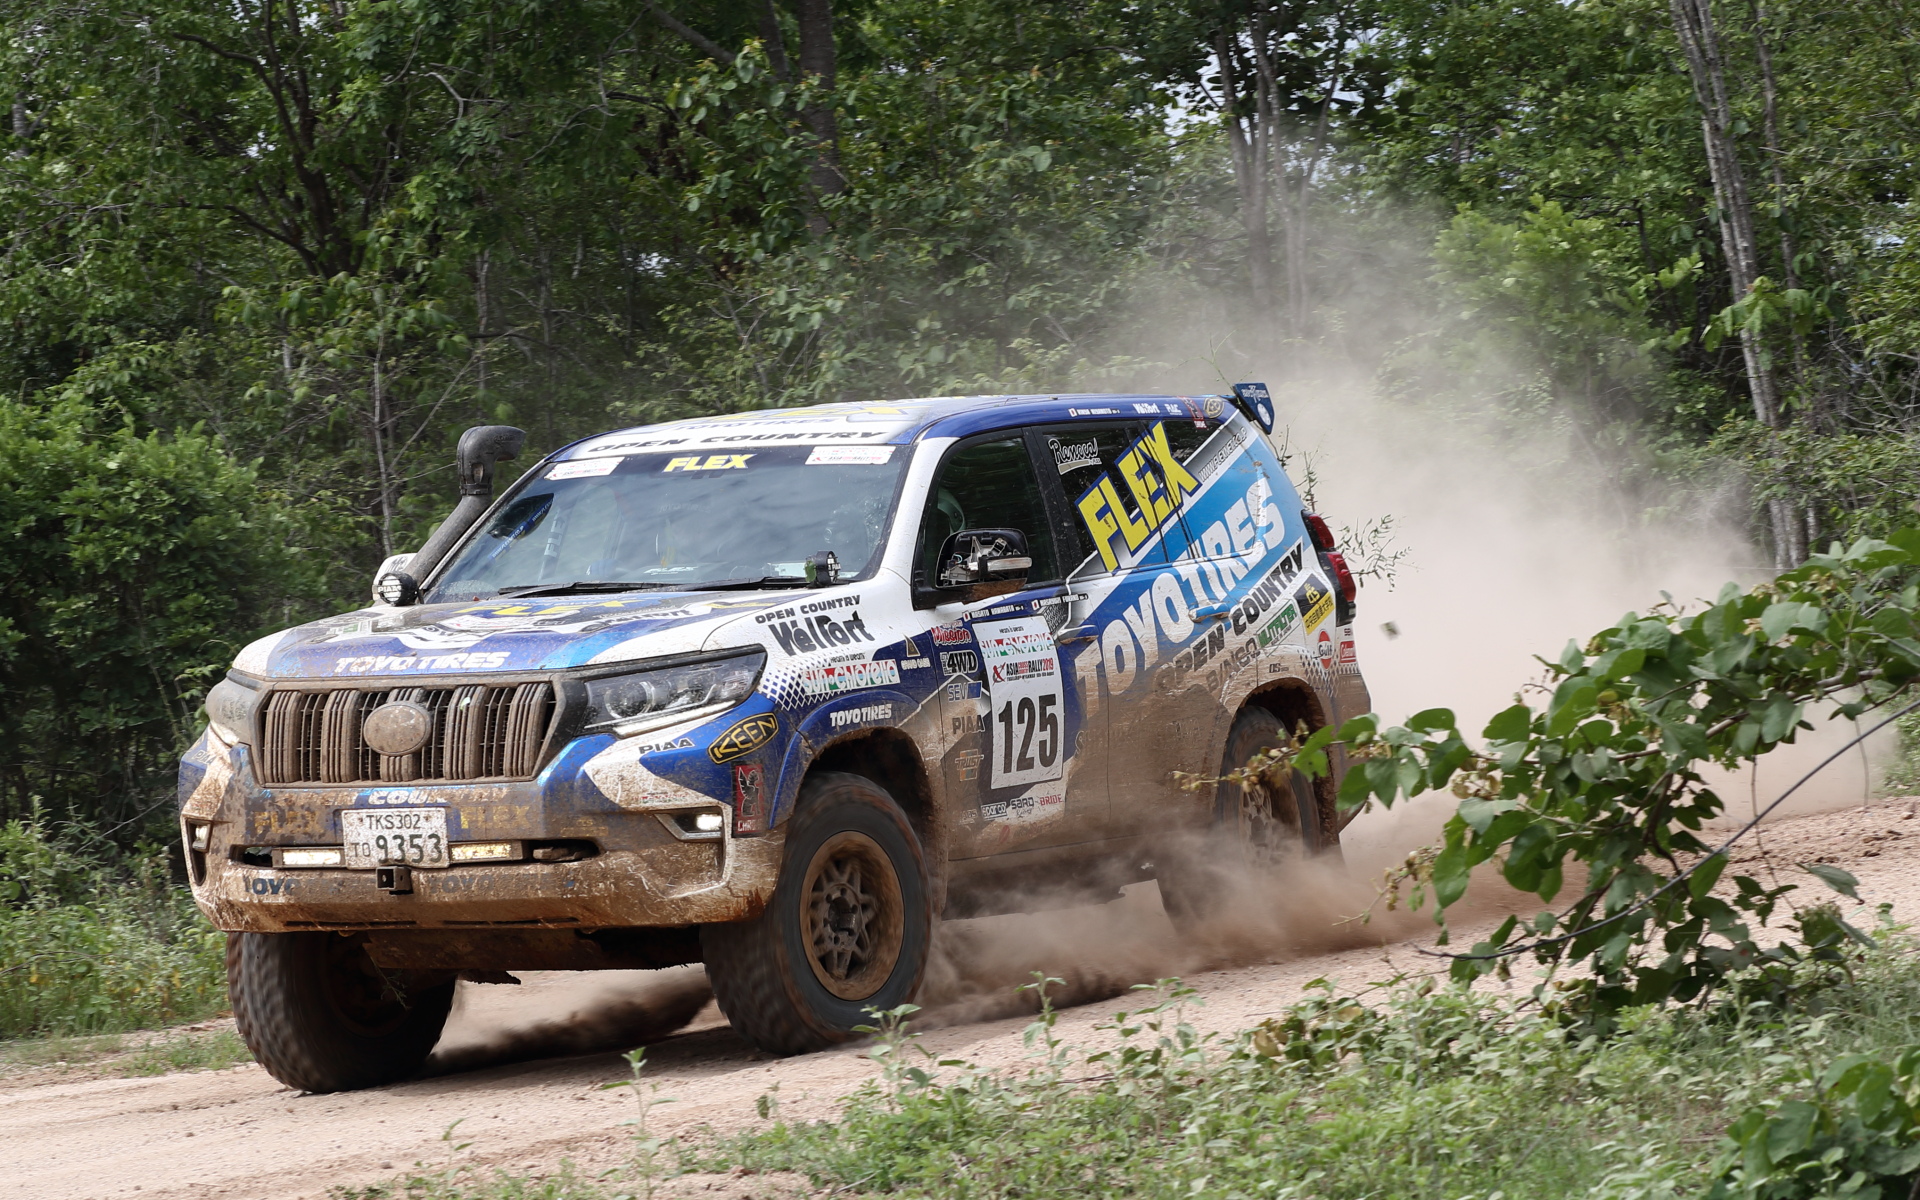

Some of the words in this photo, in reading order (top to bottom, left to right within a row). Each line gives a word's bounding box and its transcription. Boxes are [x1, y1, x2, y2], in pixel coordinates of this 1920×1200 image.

[587, 437, 690, 453] OPEN
[700, 431, 888, 443] COUNTRY
[660, 453, 757, 474] FLEX
[1076, 419, 1202, 575] FLEX
[755, 607, 796, 624] OPEN
[800, 595, 861, 615] COUNTRY
[1073, 573, 1194, 720] TOYO
[1172, 478, 1285, 609] TIRES
[1155, 622, 1226, 697] OPEN
[1232, 543, 1303, 636] COUNTRY
[335, 655, 417, 673] TOYO
[418, 651, 511, 669] TIRES
[947, 651, 977, 674] 4WD
[830, 709, 861, 727] TOYO
[861, 704, 892, 721] TIRES
[953, 715, 985, 735] PIAA
[714, 717, 776, 759] KEEN
[998, 694, 1059, 774] 125
[638, 738, 695, 754] PIAA
[1040, 794, 1062, 806] BRIDE
[366, 814, 421, 829] TKS302
[375, 833, 442, 863] 9353
